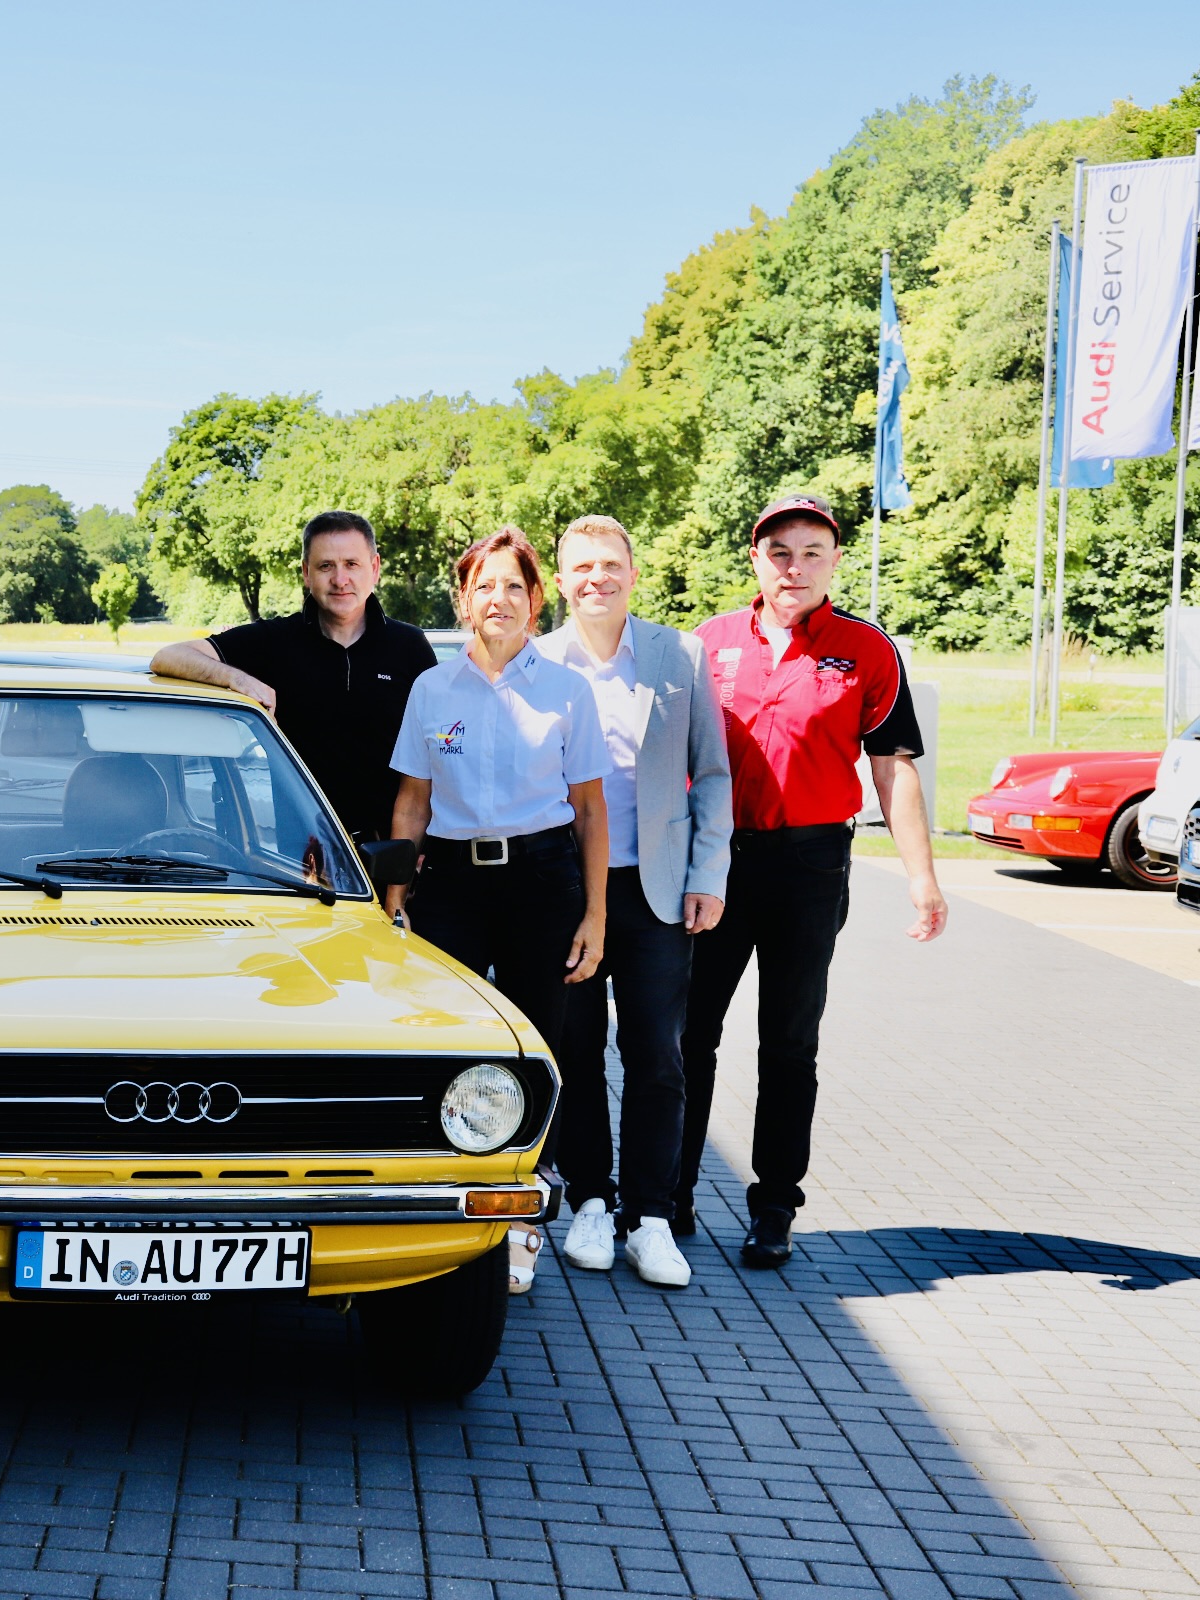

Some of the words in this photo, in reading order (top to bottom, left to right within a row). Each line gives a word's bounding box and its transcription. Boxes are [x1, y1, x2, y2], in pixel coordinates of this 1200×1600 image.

[1093, 183, 1130, 327] Service
[1082, 341, 1117, 435] Audi
[377, 673, 392, 681] BOSS
[23, 1265, 34, 1279] D
[114, 1292, 140, 1301] Audi
[142, 1292, 187, 1301] Tradition
